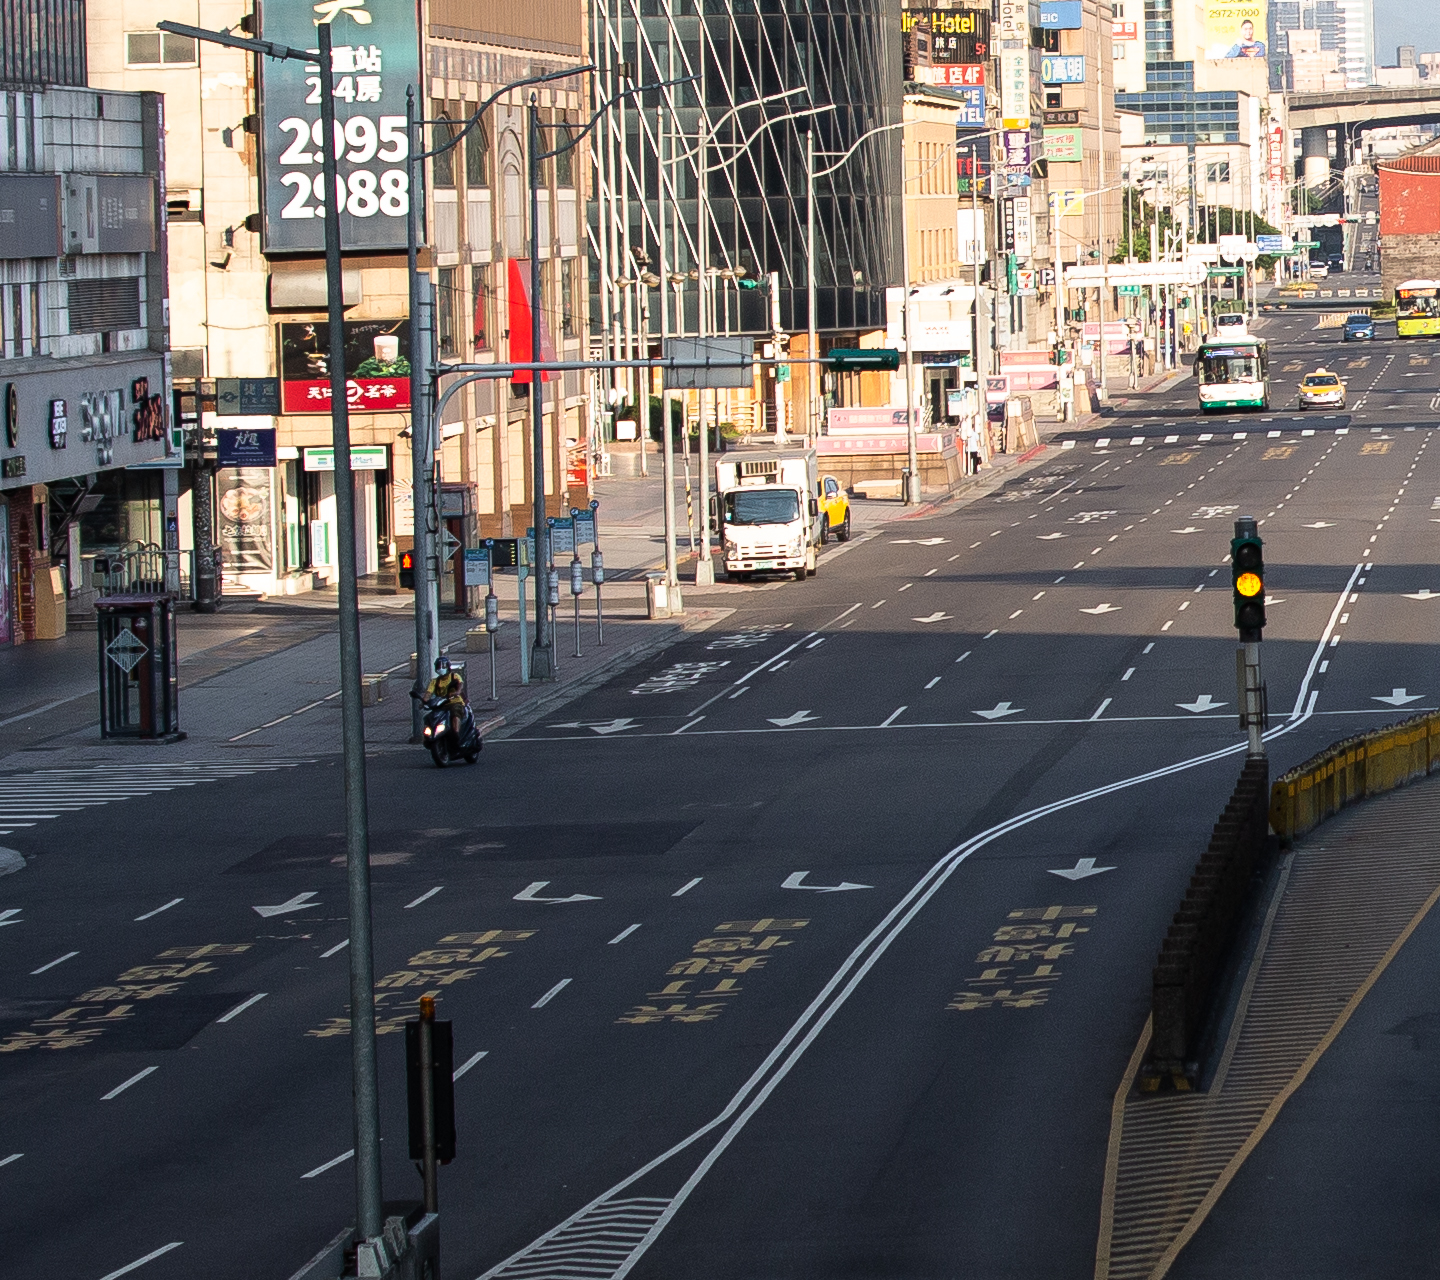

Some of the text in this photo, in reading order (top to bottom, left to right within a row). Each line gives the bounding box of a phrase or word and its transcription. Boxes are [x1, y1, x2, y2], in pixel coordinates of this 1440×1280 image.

[931, 12, 975, 34] Hotel
[305, 75, 382, 104] 24房
[278, 115, 409, 165] 2995
[306, 384, 398, 400] 天仁 茗茶
[989, 380, 1005, 390] Z4
